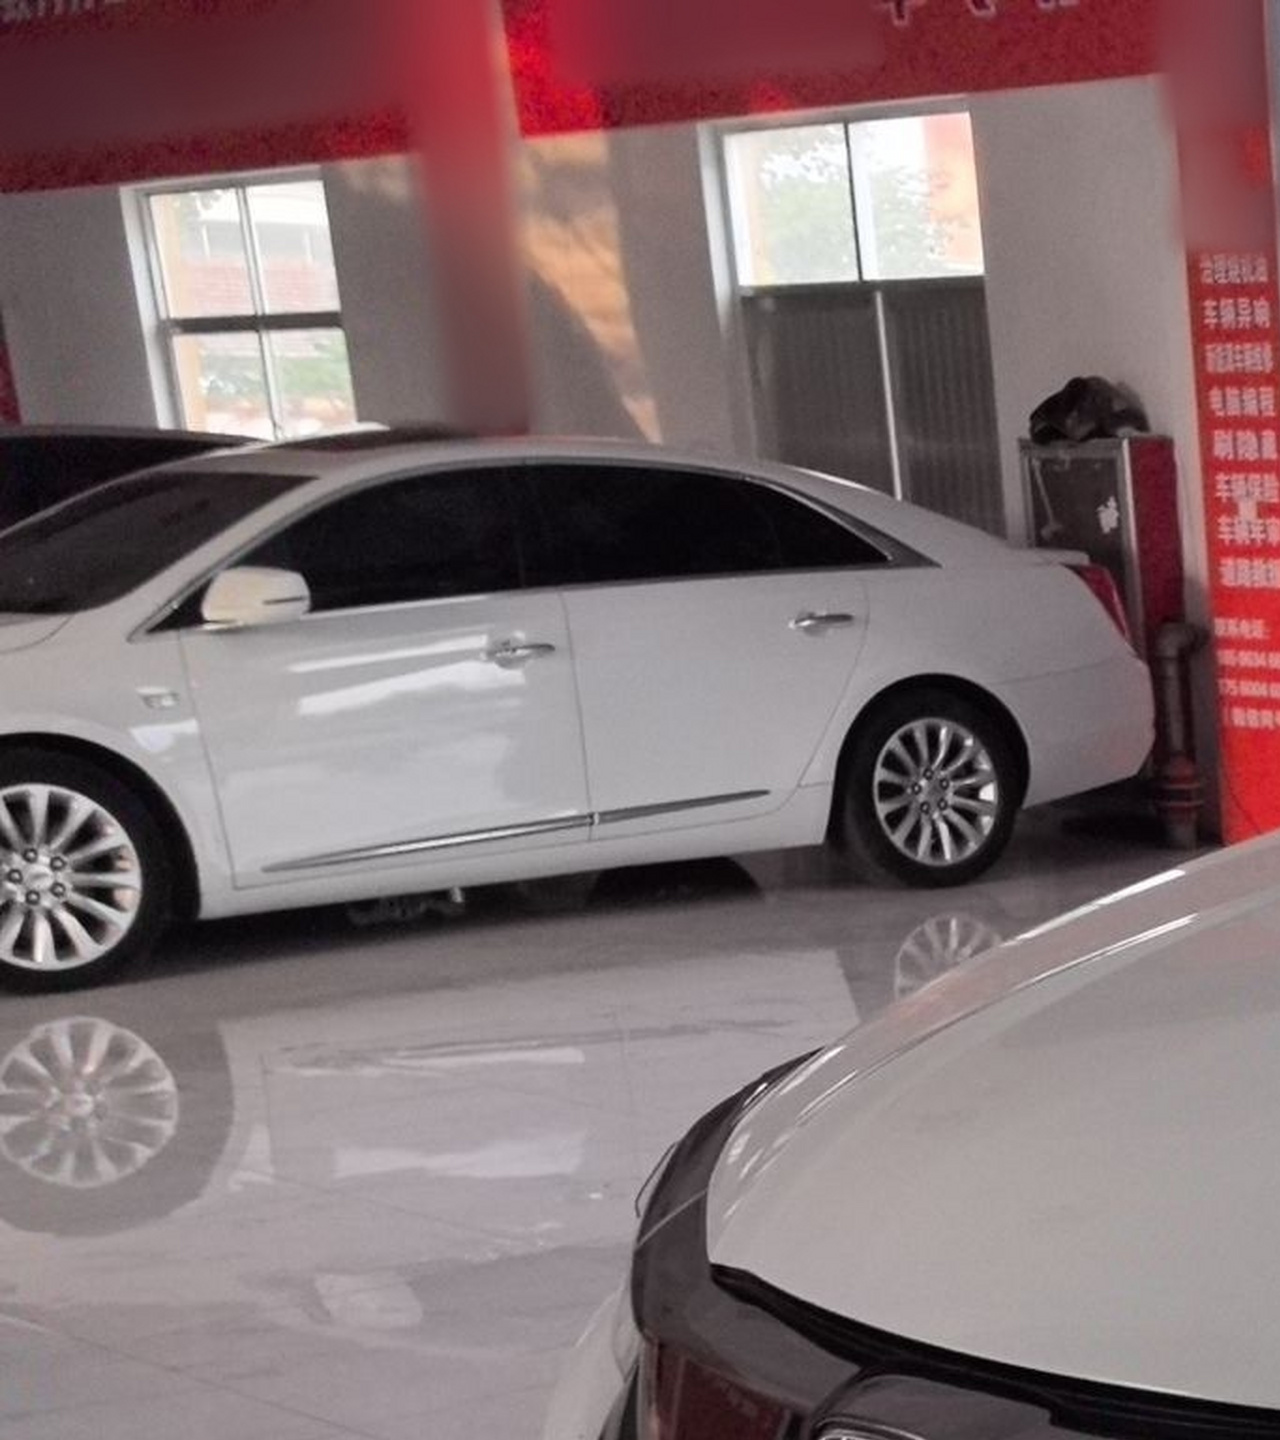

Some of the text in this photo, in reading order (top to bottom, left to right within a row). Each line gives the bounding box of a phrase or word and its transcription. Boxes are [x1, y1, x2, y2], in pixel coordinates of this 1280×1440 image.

[1203, 297, 1271, 330] 车辆异响
[1209, 386, 1276, 418] 电脑编程
